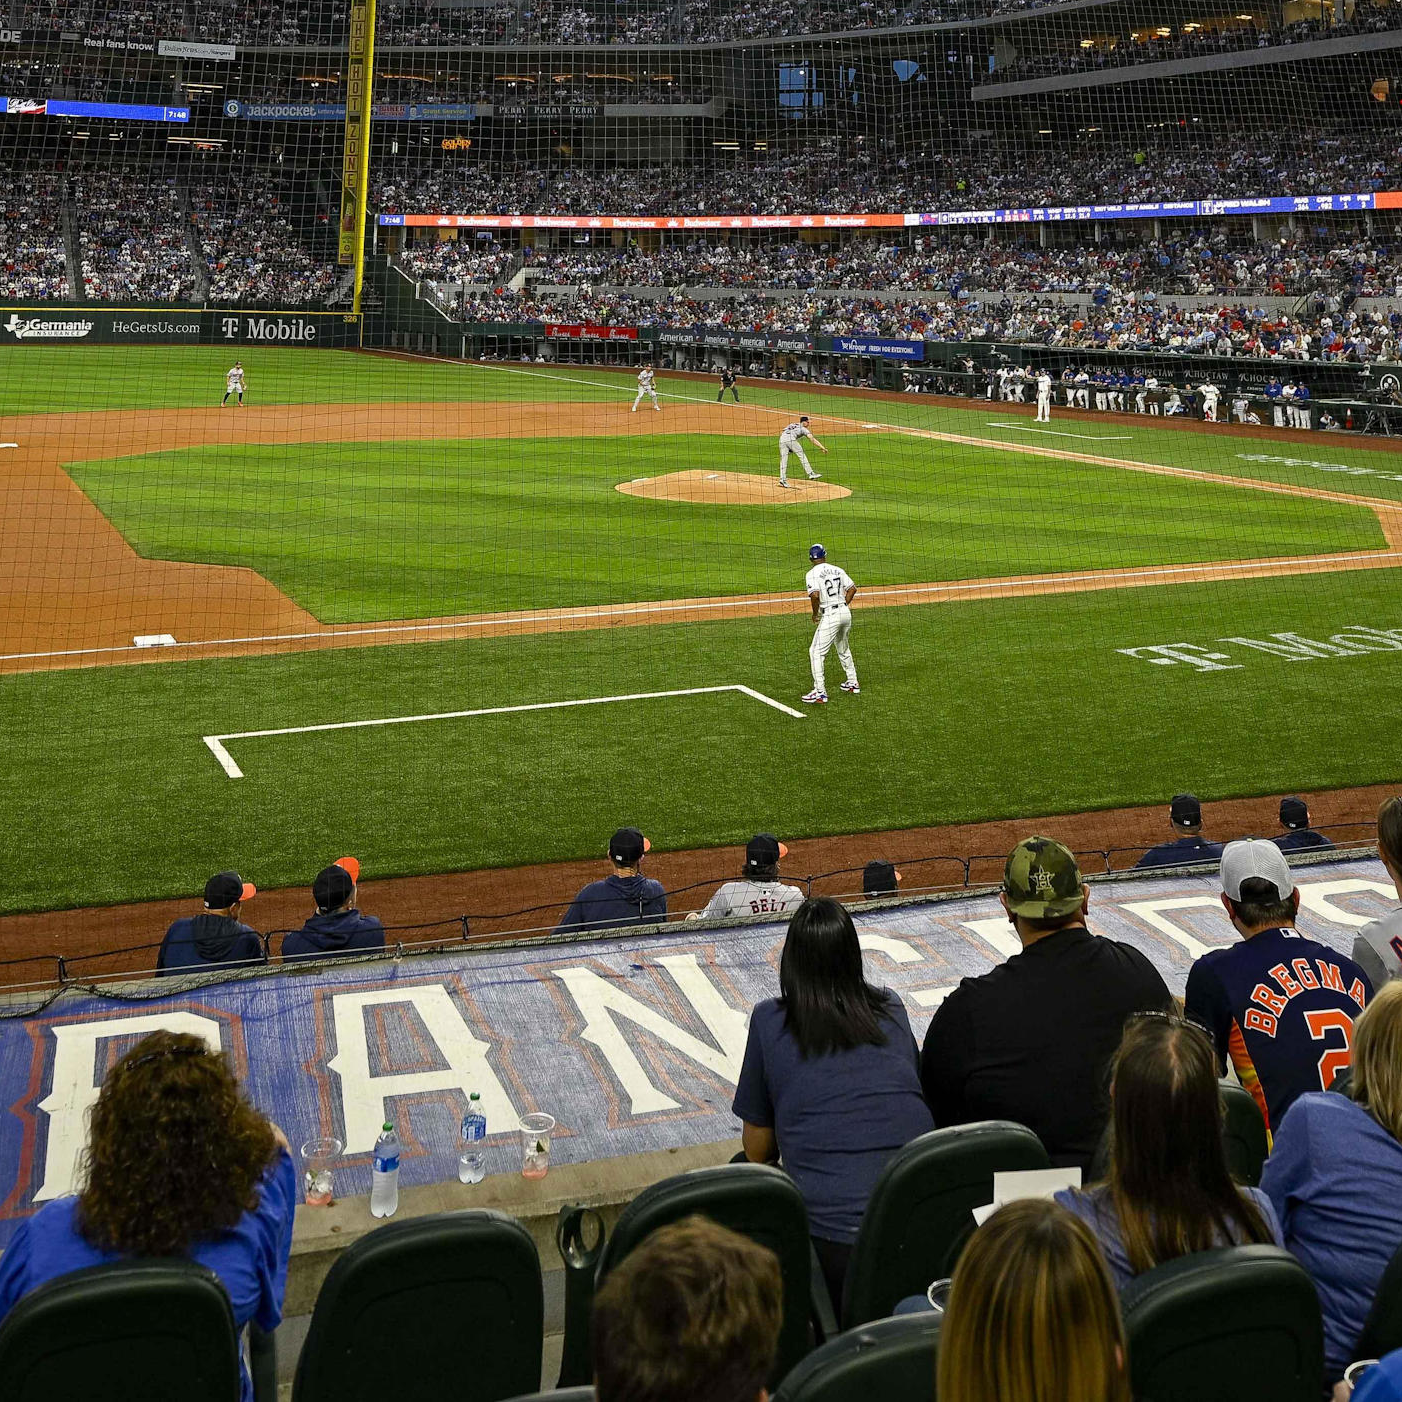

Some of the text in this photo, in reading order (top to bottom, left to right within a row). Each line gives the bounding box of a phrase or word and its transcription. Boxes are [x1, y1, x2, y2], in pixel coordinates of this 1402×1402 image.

[83, 37, 105, 49] Real
[106, 38, 126, 50] fans
[126, 40, 154, 52] know.
[344, 125, 359, 188] ZONE
[457, 216, 500, 227] Budweiser
[533, 216, 578, 227] Budweiser
[612, 216, 656, 228] Budweiser
[683, 216, 722, 227] Budweiser
[30, 318, 93, 331] Germania
[343, 314, 358, 324] 326
[112, 321, 200, 335] HeGetsUs.com
[246, 318, 316, 341] Mobile
[658, 332, 694, 344] American
[704, 334, 730, 346] American
[738, 337, 767, 348] American
[777, 339, 805, 350] American
[824, 577, 841, 597] 27
[1244, 958, 1367, 1039] BREGMA
[1303, 1008, 1355, 1092] 2
